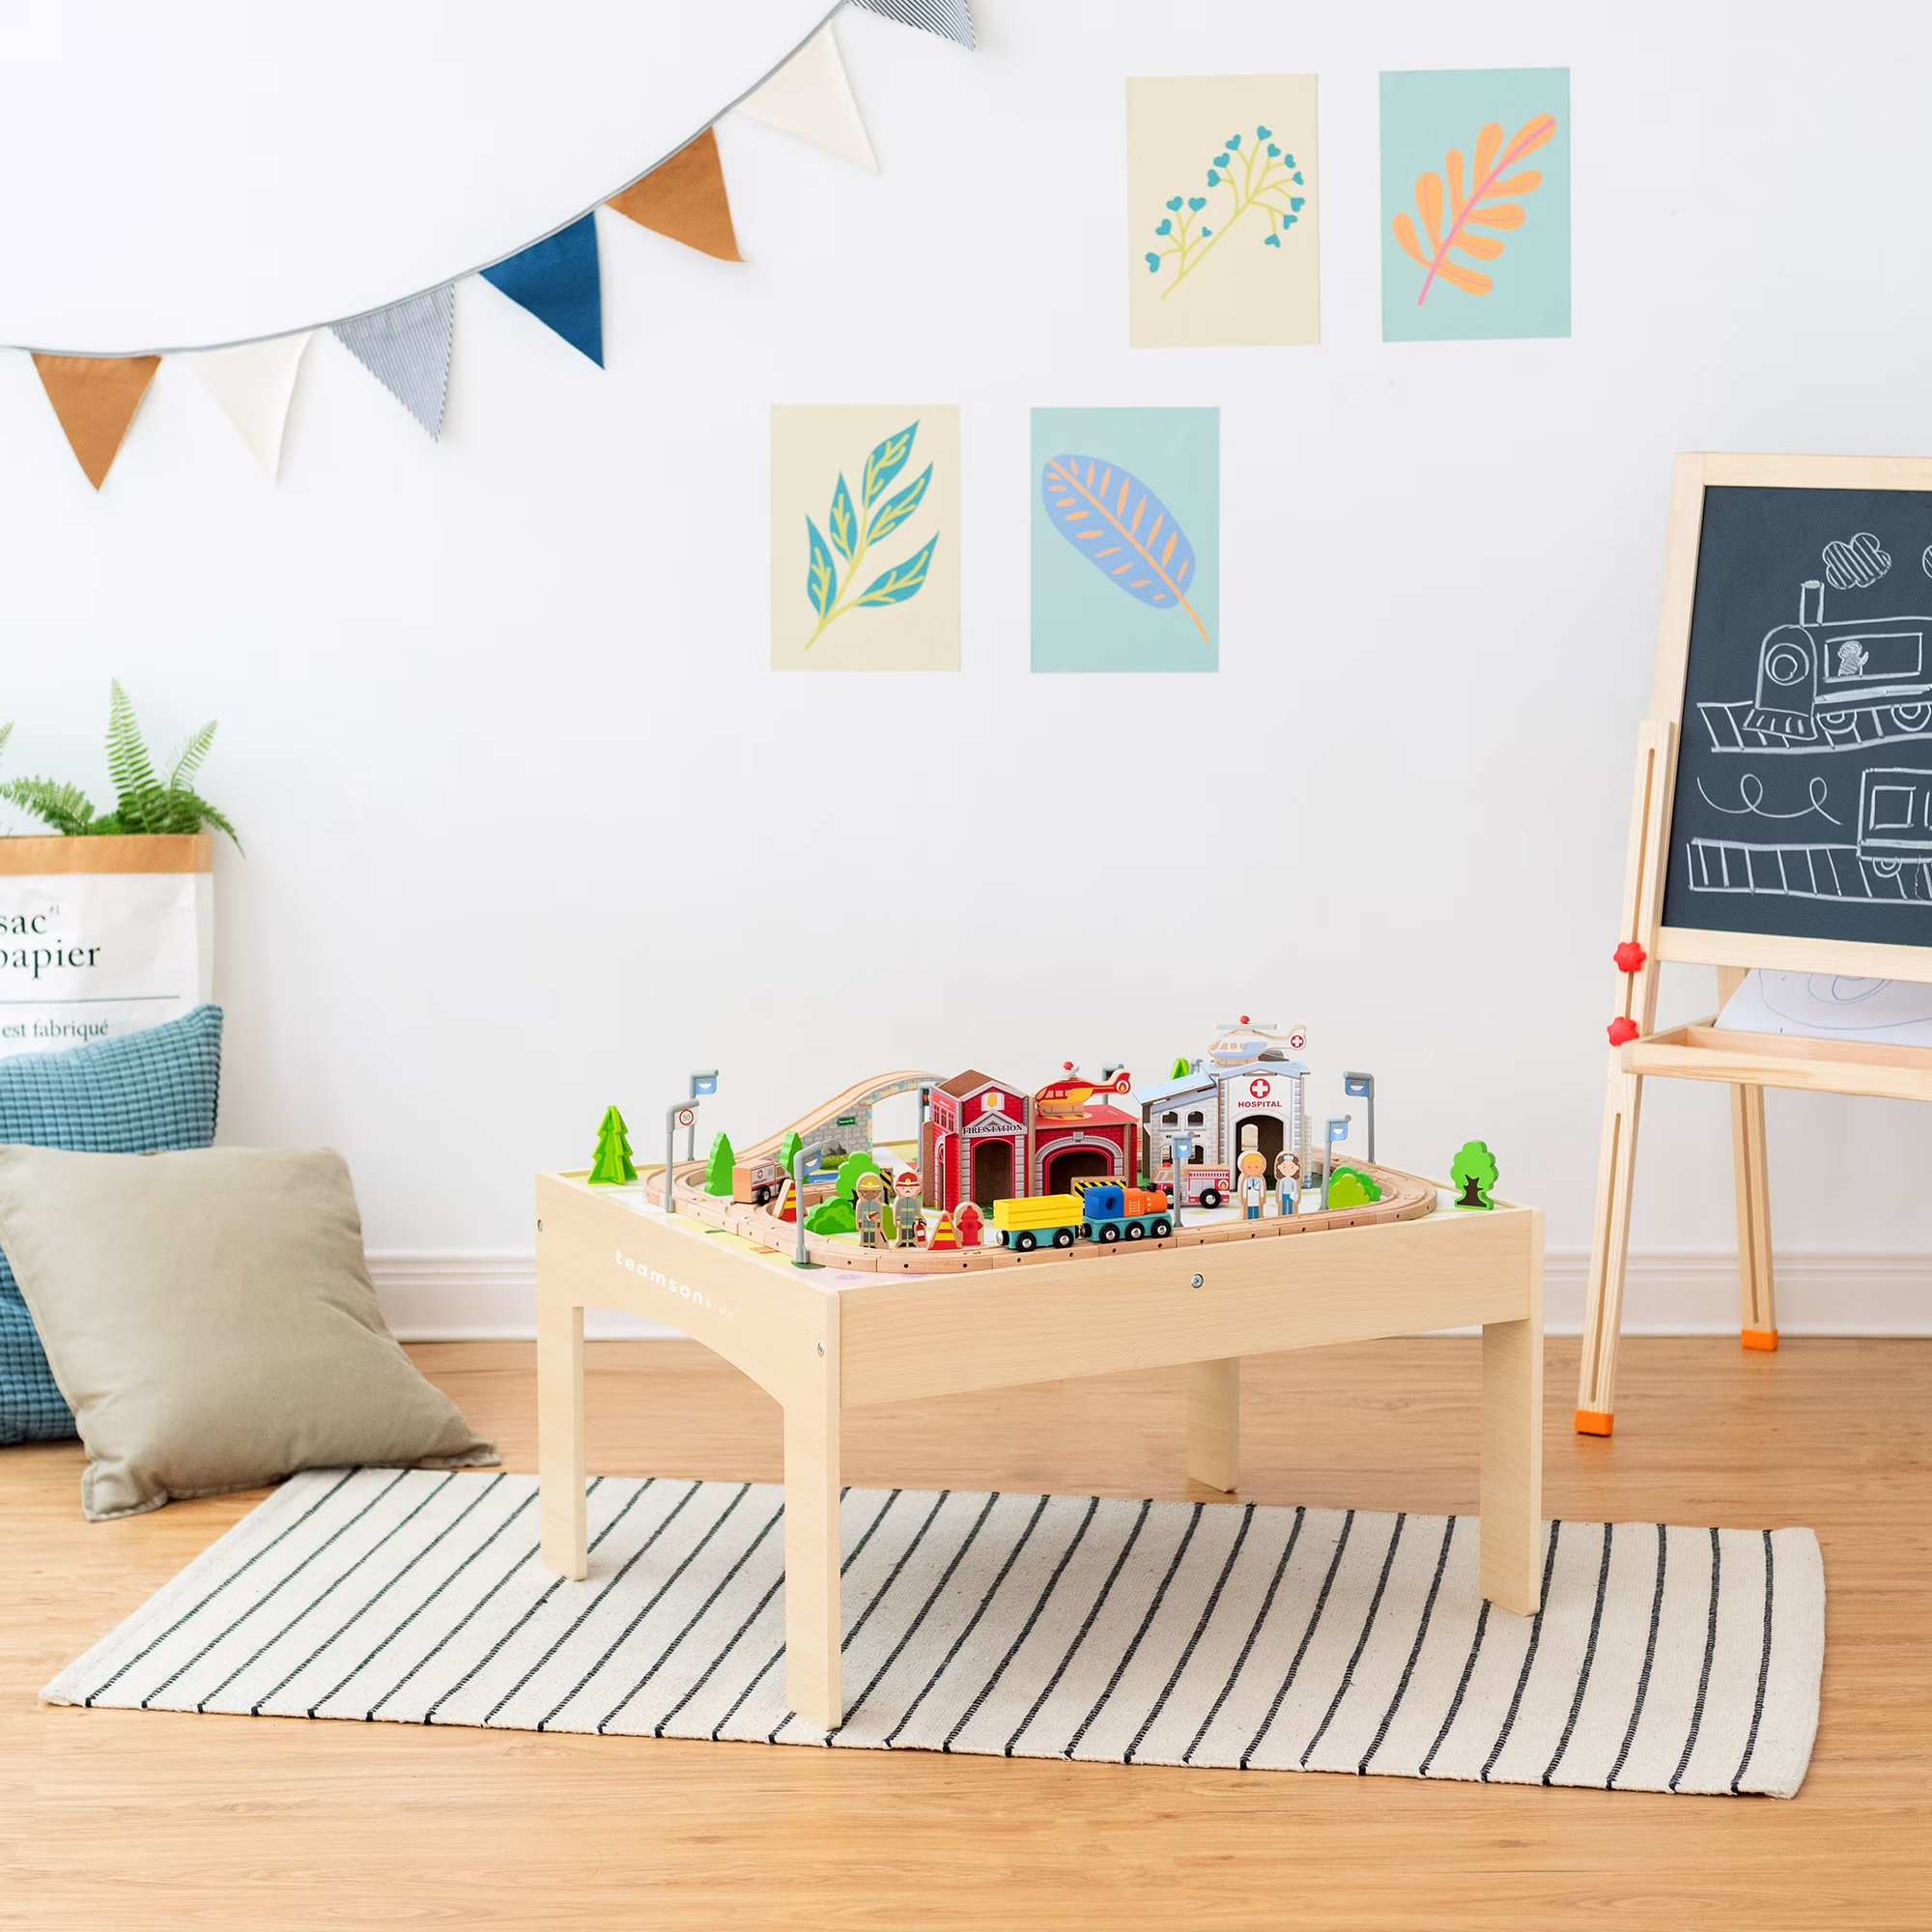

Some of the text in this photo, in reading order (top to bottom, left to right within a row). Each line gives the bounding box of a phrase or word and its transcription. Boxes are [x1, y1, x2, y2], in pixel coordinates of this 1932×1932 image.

[2, 1019, 109, 1042] est fabriqué
[963, 1123, 1023, 1135] FIRE STATION
[615, 1250, 703, 1306] teamson
